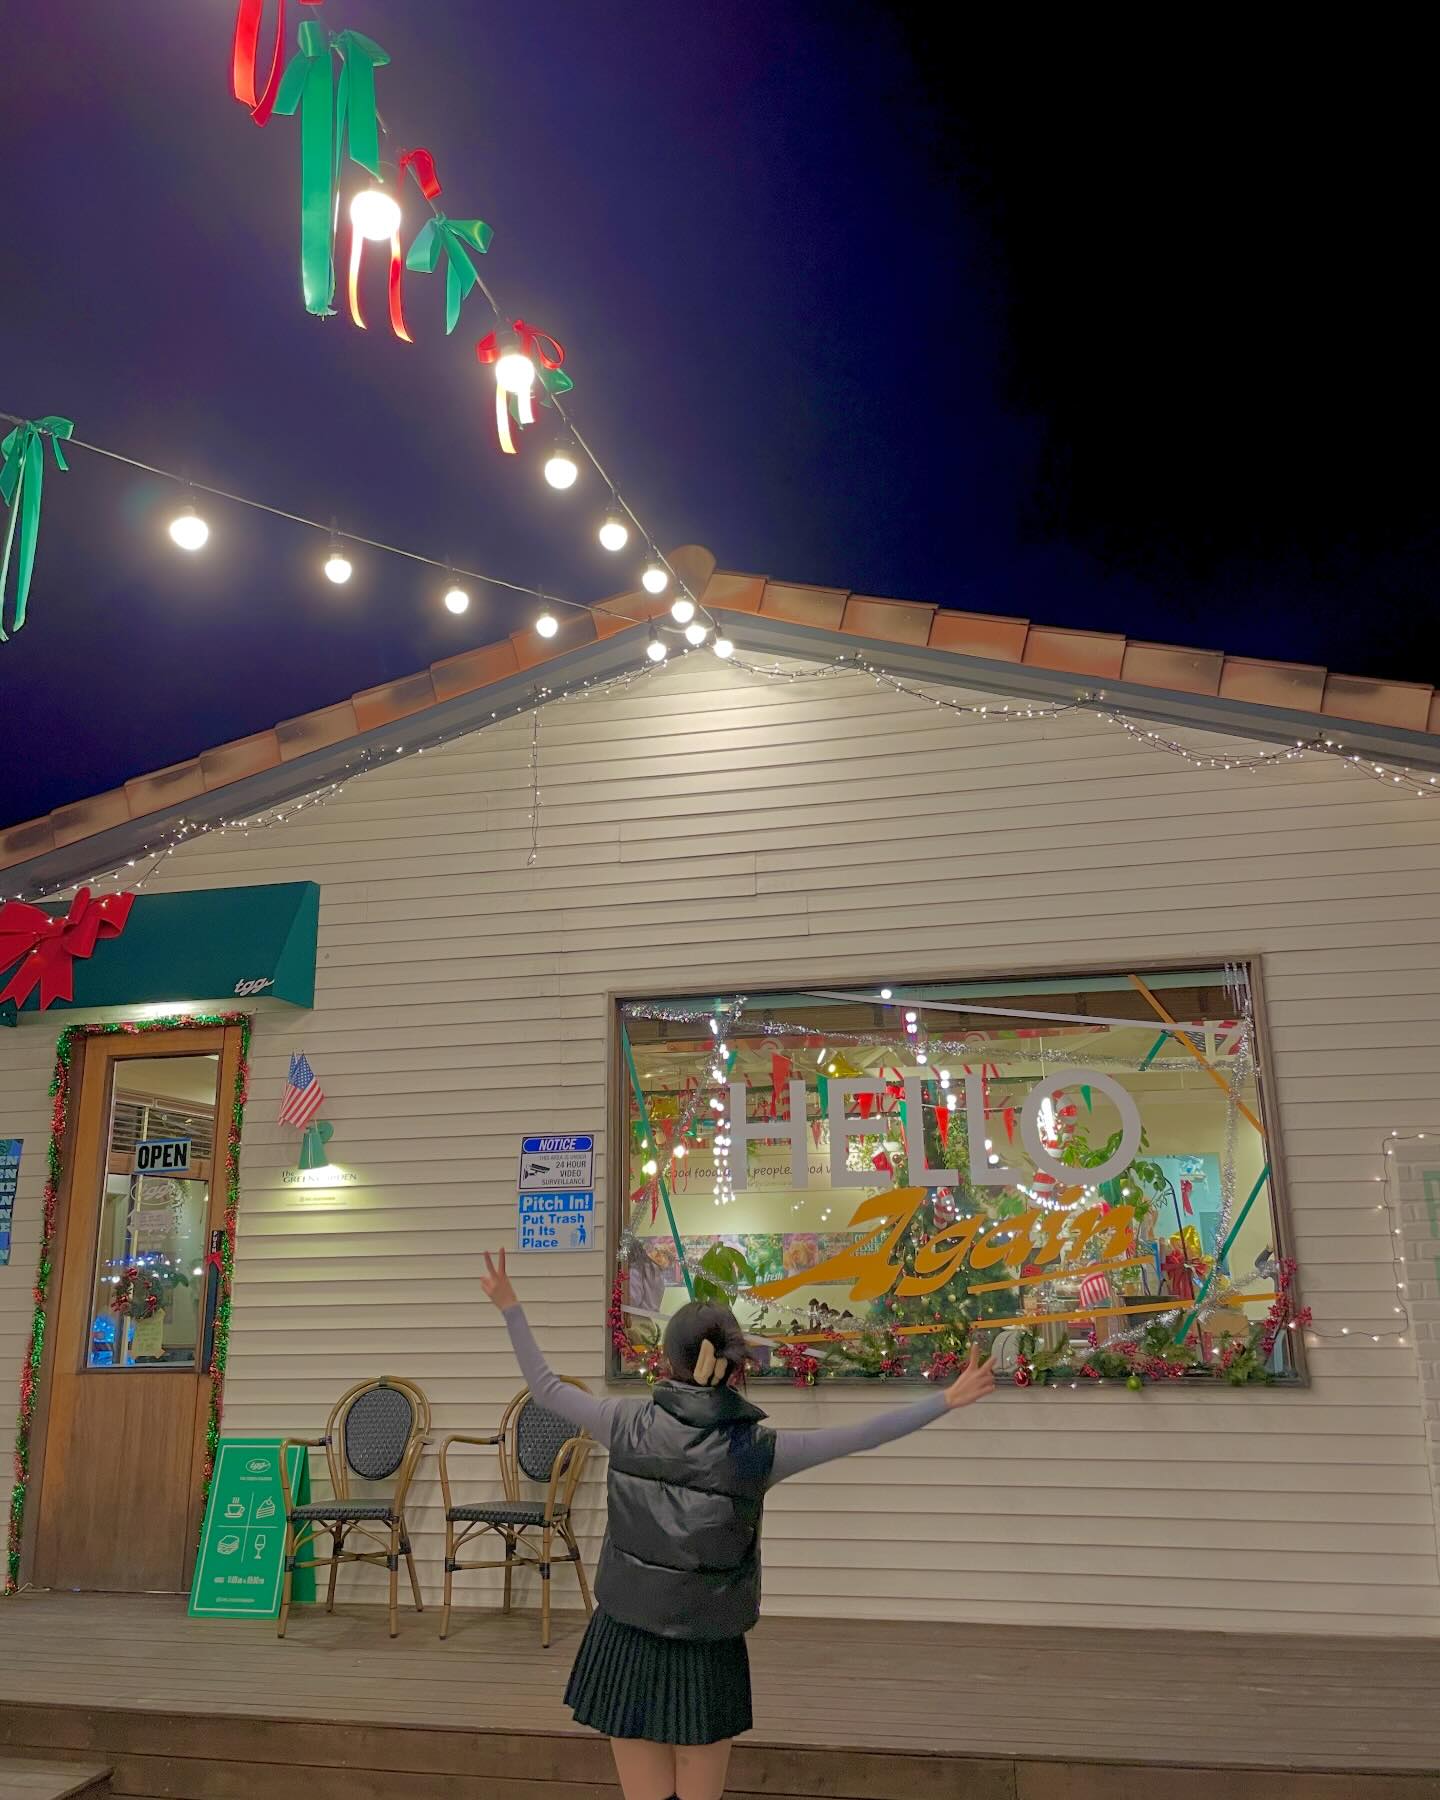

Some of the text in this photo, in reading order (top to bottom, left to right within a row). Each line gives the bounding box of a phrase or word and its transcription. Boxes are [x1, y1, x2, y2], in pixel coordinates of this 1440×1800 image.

[234, 978, 275, 997] tgg
[729, 1067, 1141, 1191] HELLO
[538, 1138, 577, 1151] NOTICE
[137, 1143, 188, 1169] OPEN
[555, 1160, 587, 1169] 24 HOUR
[559, 1170, 582, 1178] VIDEO
[542, 1178, 585, 1186] SURVEILLANCE
[522, 1193, 590, 1212] Pitch In!
[522, 1213, 585, 1225] Put Trash
[522, 1226, 556, 1237] In Its
[522, 1238, 559, 1249] Place
[748, 1185, 1136, 1300] Again
